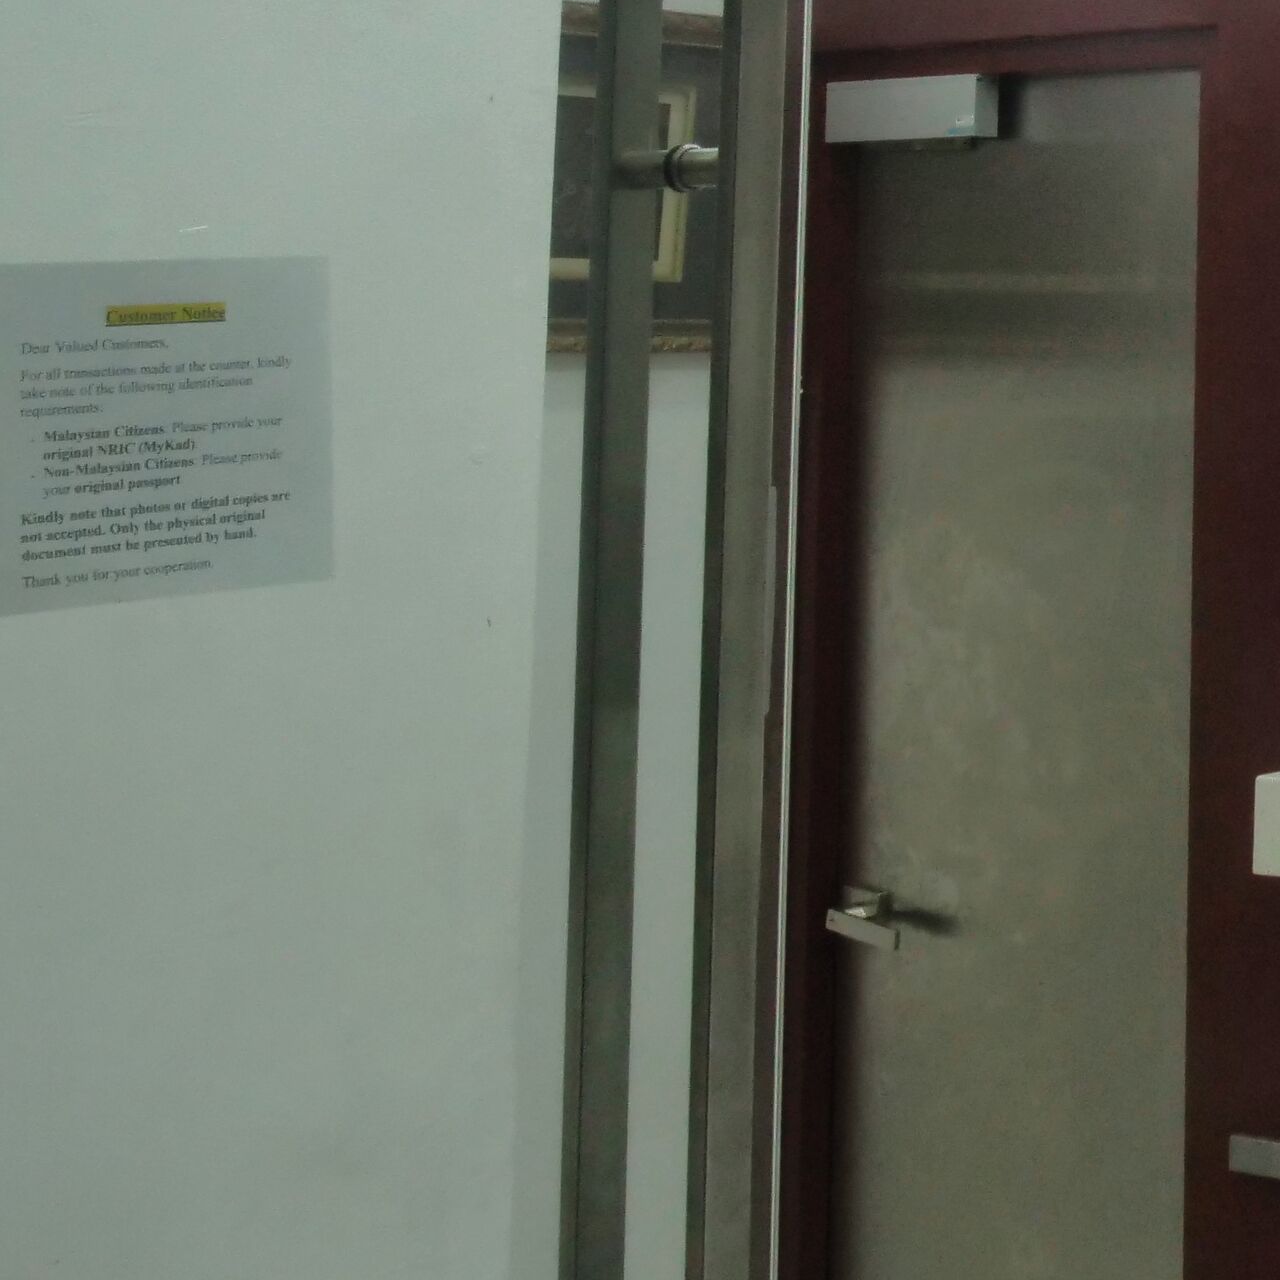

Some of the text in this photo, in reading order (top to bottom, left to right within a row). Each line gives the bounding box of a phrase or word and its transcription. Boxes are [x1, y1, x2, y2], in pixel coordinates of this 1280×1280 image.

[106, 307, 225, 323] Customer Notice
[45, 430, 109, 442] Malaysian
[43, 443, 135, 461] original NRIC
[74, 480, 123, 493] original
[22, 511, 64, 525] Kindly
[71, 510, 96, 521] note
[102, 506, 126, 518] that
[131, 504, 170, 517] photos
[191, 495, 229, 509] digital
[233, 494, 268, 507] copies
[272, 492, 290, 501] are
[21, 510, 265, 543] not Only the physical original
[22, 532, 219, 561] document must be presented by
[22, 574, 61, 588] Thank
